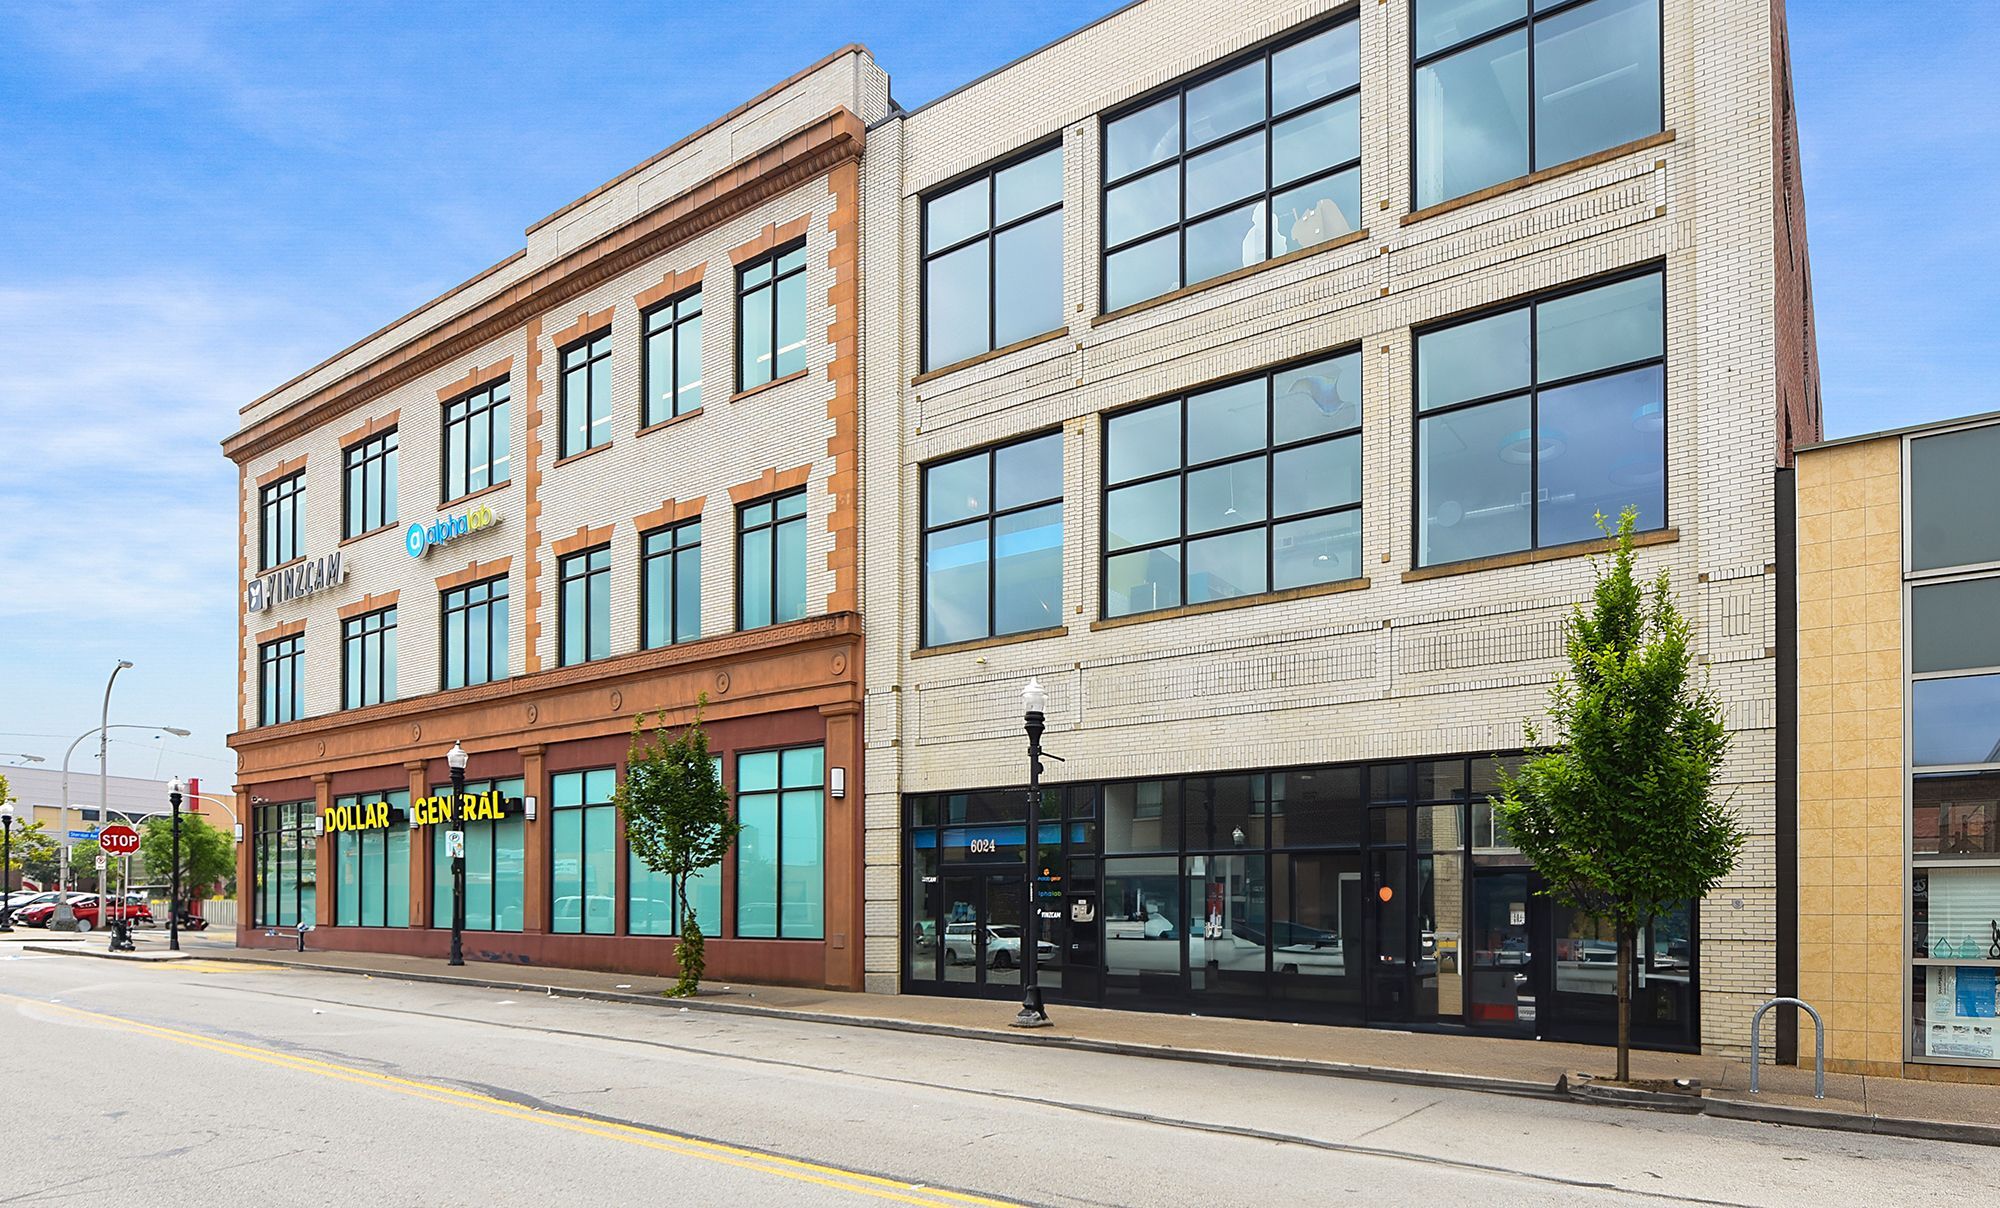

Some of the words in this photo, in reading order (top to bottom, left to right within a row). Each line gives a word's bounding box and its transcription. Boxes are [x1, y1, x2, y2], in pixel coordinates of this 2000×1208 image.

[426, 503, 491, 545] alphalab
[267, 551, 341, 607] YINZCAM
[325, 801, 390, 833] DOLLAR
[102, 834, 138, 847] STOP
[970, 839, 996, 853] 6024
